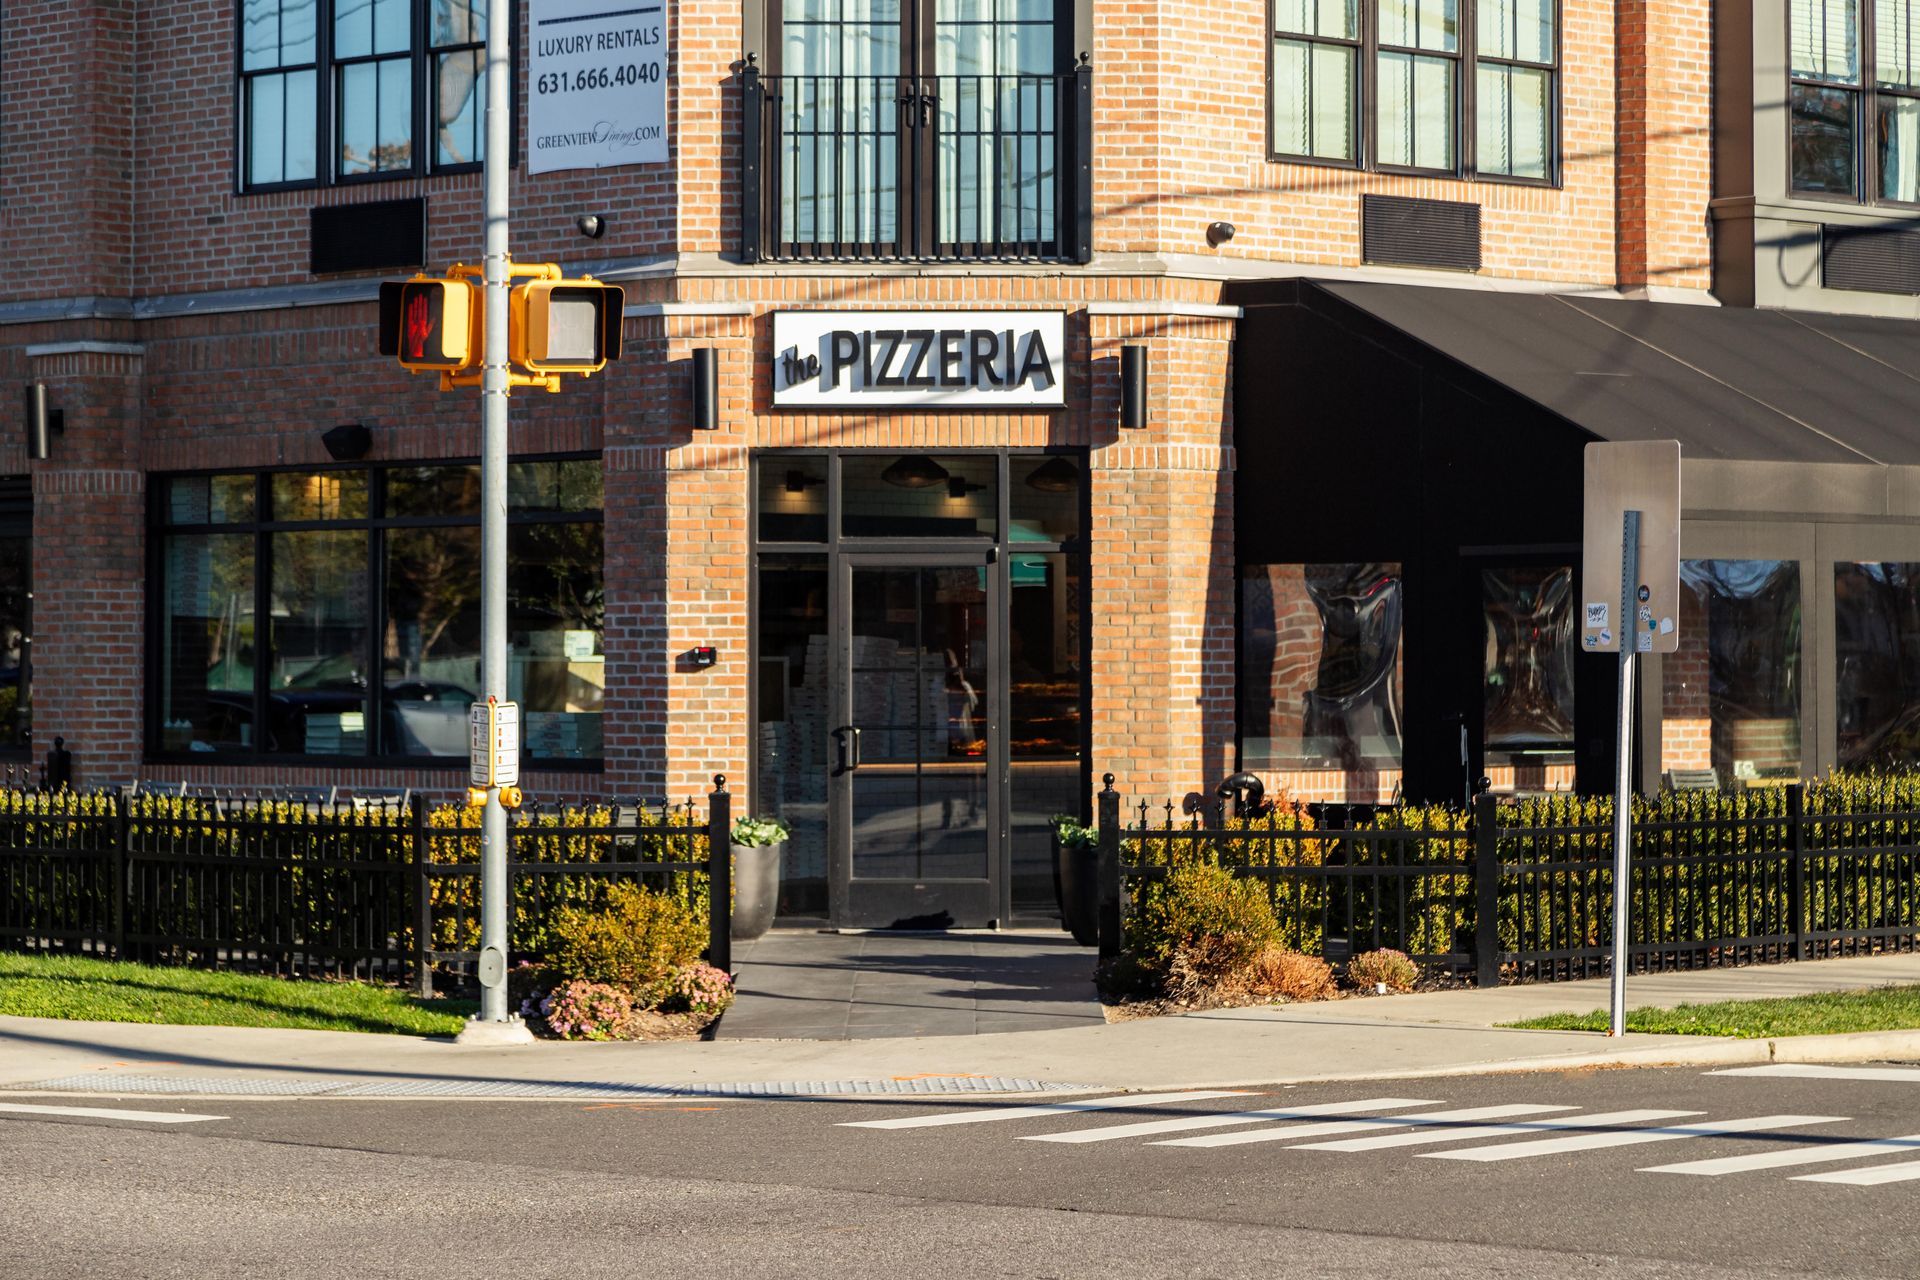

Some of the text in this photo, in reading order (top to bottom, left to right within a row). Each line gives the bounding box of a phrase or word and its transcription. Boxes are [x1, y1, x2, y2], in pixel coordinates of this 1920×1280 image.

[538, 26, 660, 57] LUXURY RENTALS
[538, 61, 660, 95] 631.666.4040
[781, 329, 1056, 386] the PIZZERIA
